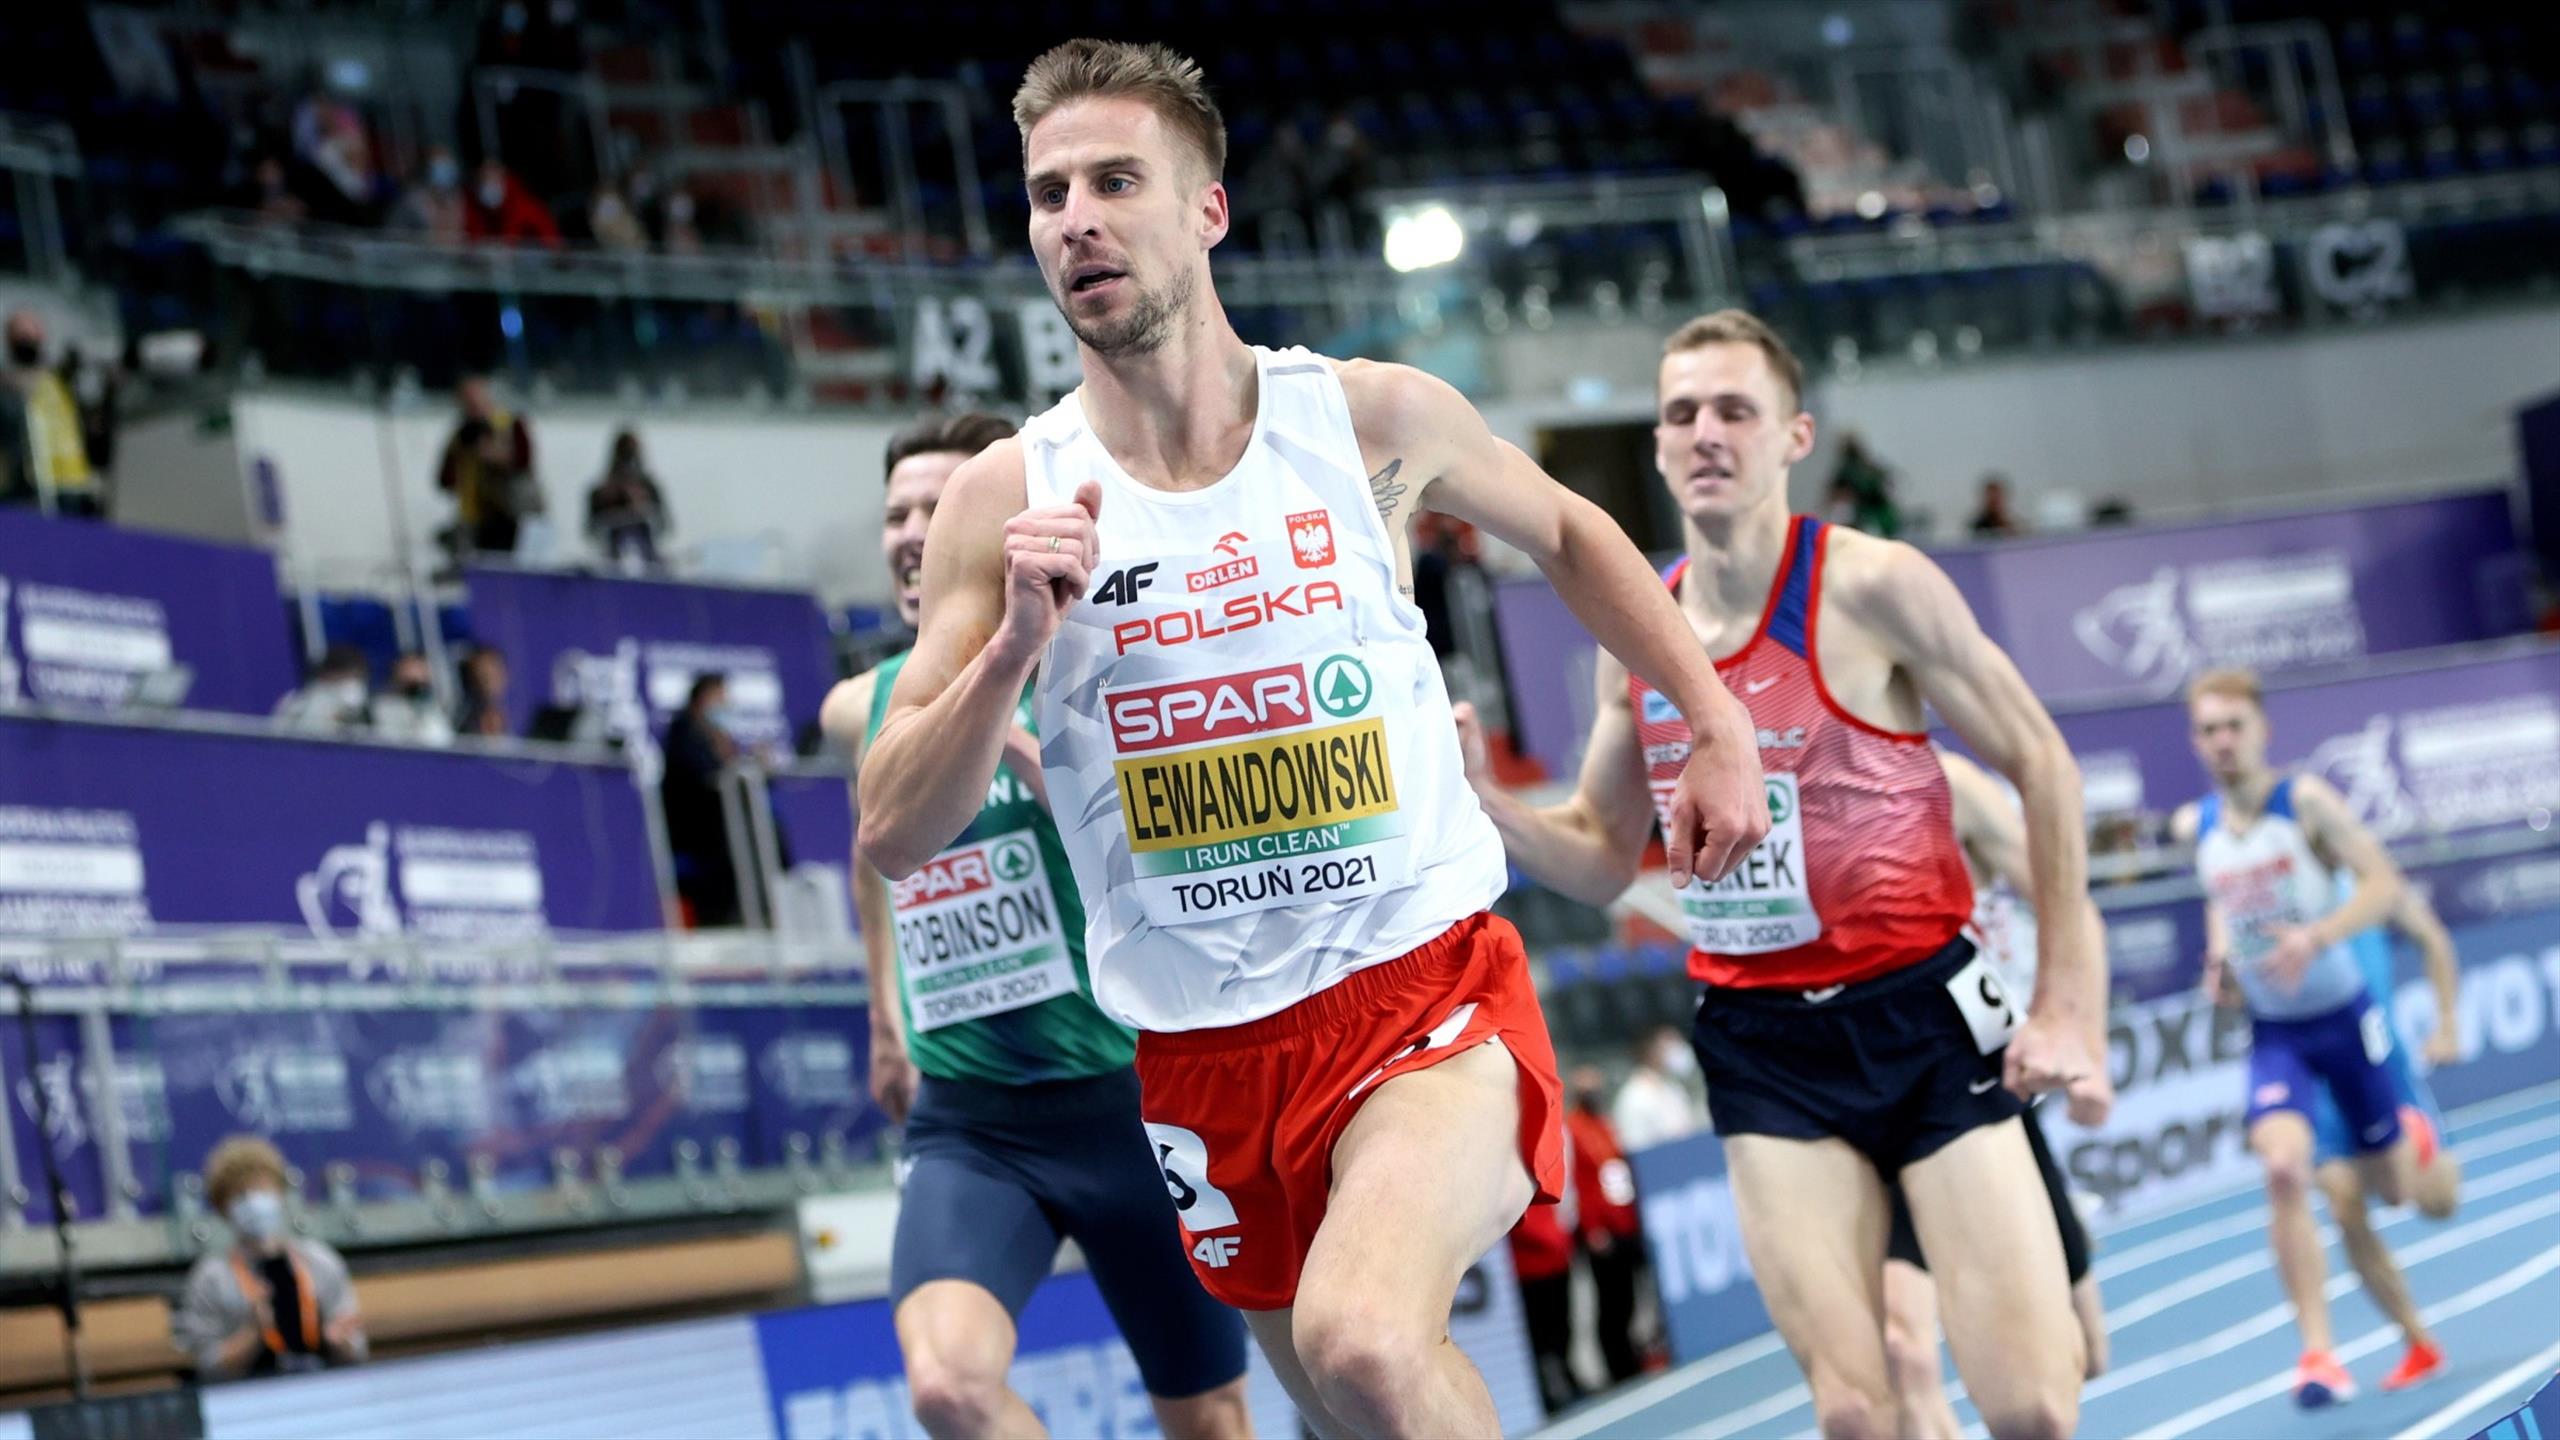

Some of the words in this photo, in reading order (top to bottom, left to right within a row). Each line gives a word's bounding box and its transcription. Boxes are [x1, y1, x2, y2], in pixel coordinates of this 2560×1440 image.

[912, 298, 999, 388] A2
[1287, 510, 1327, 524] POLSKA
[1092, 562, 1159, 606] 4F
[1190, 559, 1254, 591] ORLEN
[1113, 581, 1343, 656] POLSKA
[1113, 673, 1305, 744] SPAR
[1124, 730, 1389, 840] LEWANDOWSKI
[1184, 852, 1192, 869] I
[1199, 843, 1251, 867] RUN
[1172, 865, 1294, 912] TORUŃ
[1301, 855, 1377, 893] 2021
[902, 887, 1050, 964] ROBINSON
[1000, 972, 1049, 1004] 2021
[1192, 1237, 1241, 1268] 4F
